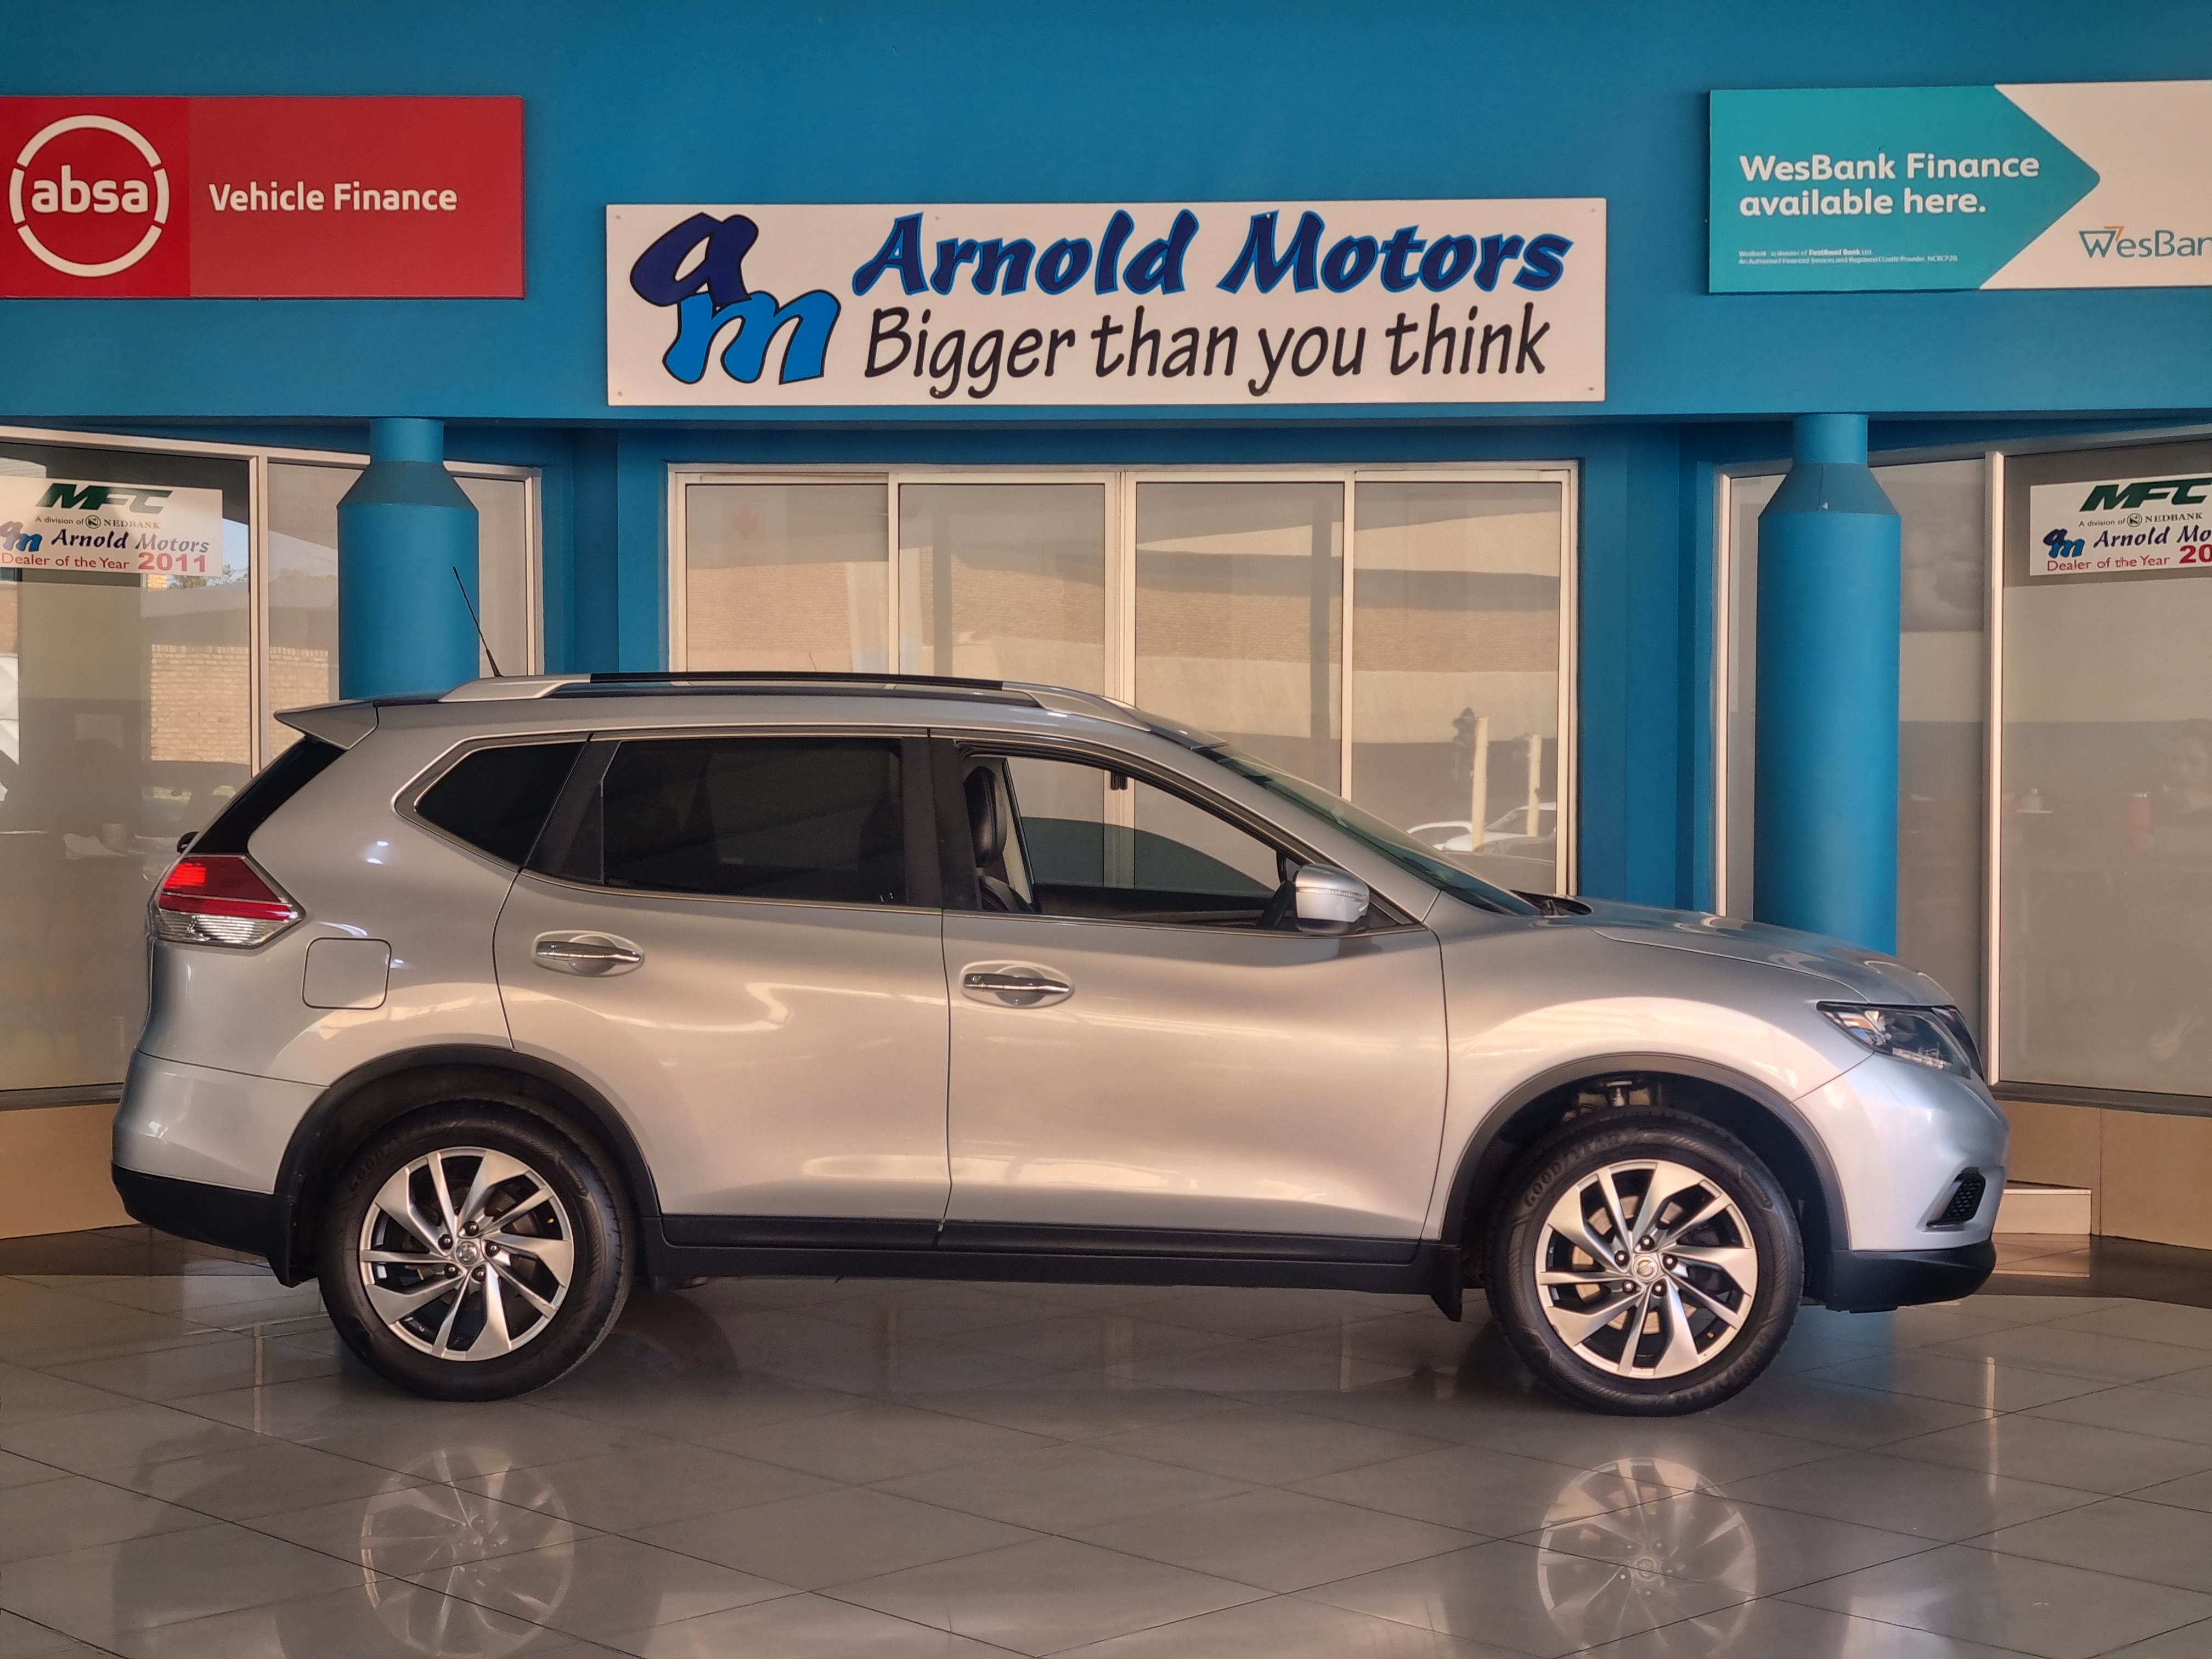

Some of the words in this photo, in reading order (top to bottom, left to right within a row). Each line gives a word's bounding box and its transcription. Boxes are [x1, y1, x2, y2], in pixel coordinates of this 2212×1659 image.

[1740, 153, 1895, 181] WesBank
[1908, 153, 2039, 179] Finance
[31, 164, 149, 213] absa
[209, 181, 324, 211] Vehicle
[334, 181, 457, 211] Finance
[1740, 188, 1893, 217] available
[1904, 187, 1986, 214] here.
[851, 209, 1199, 296] Arnold
[1216, 210, 1574, 295] Motors
[865, 307, 1075, 399] Bigger
[1090, 305, 1238, 377] than
[1248, 326, 1367, 397] you
[1385, 302, 1550, 375] think
[36, 483, 174, 515] MFC
[2079, 477, 2212, 512] MFC
[44, 516, 74, 524] division
[104, 519, 161, 529] NEDBANK
[2087, 518, 2115, 527] division
[2145, 512, 2203, 523] NEDBANK
[51, 528, 129, 549] Arnold
[135, 533, 210, 553] Motors
[2093, 526, 2170, 548] Arnold
[2, 553, 50, 566] Dealer
[55, 556, 70, 567] of
[74, 557, 97, 568] the
[99, 557, 130, 569] Year
[138, 552, 206, 572] 2011
[2047, 560, 2091, 571] Dealer
[2097, 557, 2111, 568] of
[2115, 556, 2137, 568] the
[2140, 555, 2170, 567] Year
